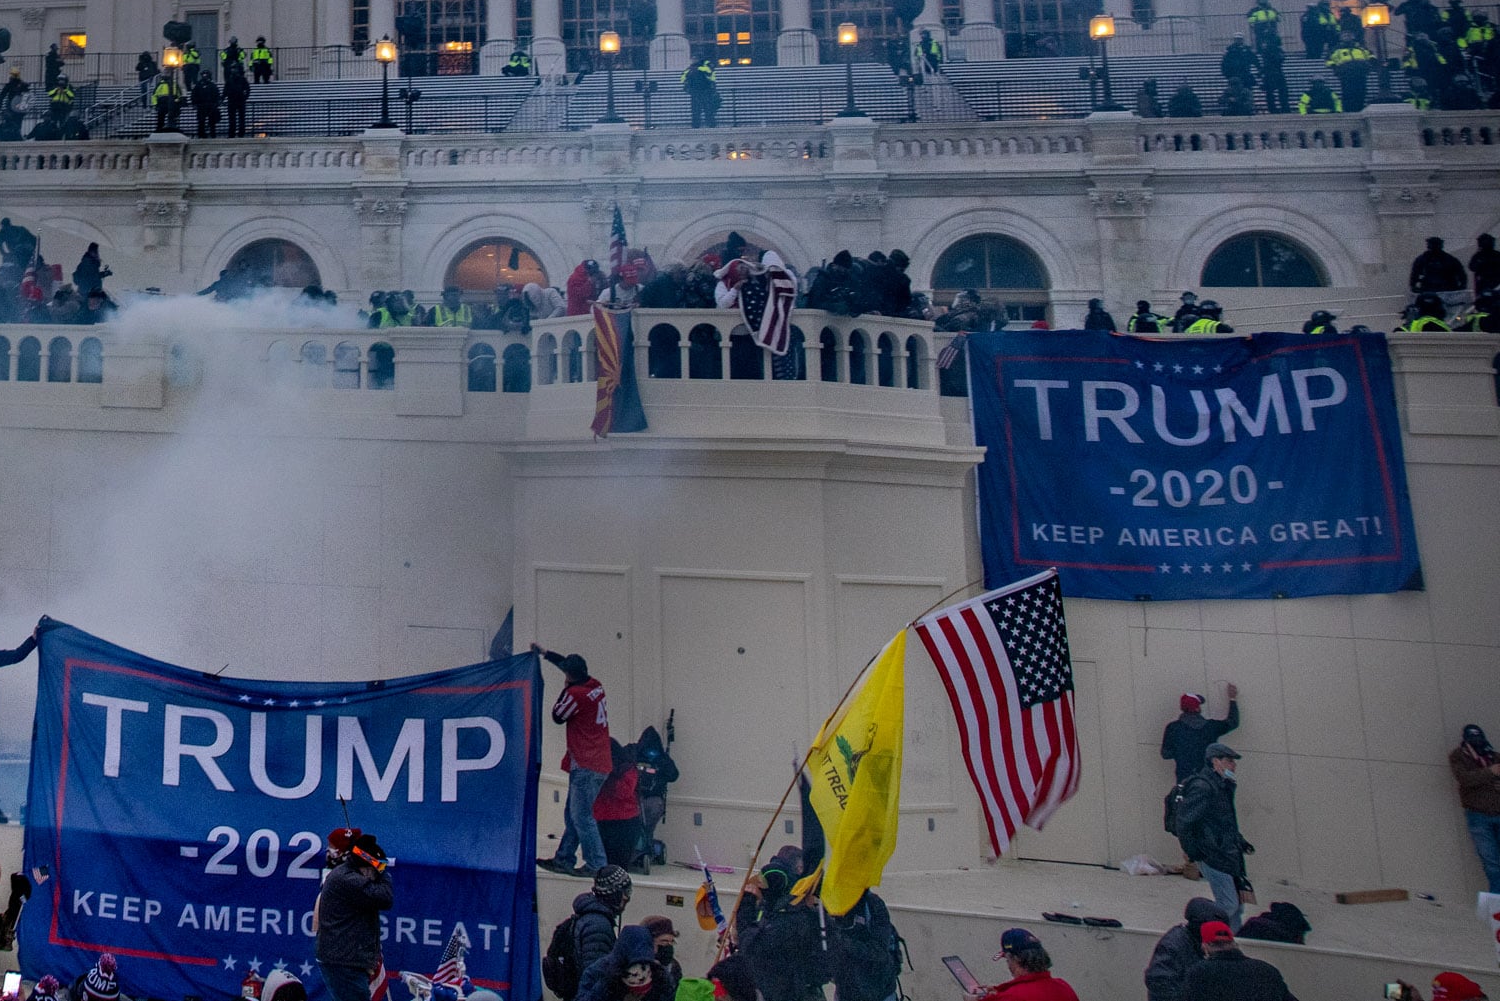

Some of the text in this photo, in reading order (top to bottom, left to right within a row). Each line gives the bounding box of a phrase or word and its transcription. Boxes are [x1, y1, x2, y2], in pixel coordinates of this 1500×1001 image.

[1014, 366, 1348, 446] TRUMP
[1032, 515, 1383, 547] KEEP AMERICA GREAT!
[82, 692, 506, 803] TRUMP
[73, 889, 162, 924] KEEP
[177, 903, 318, 938] AMERIC
